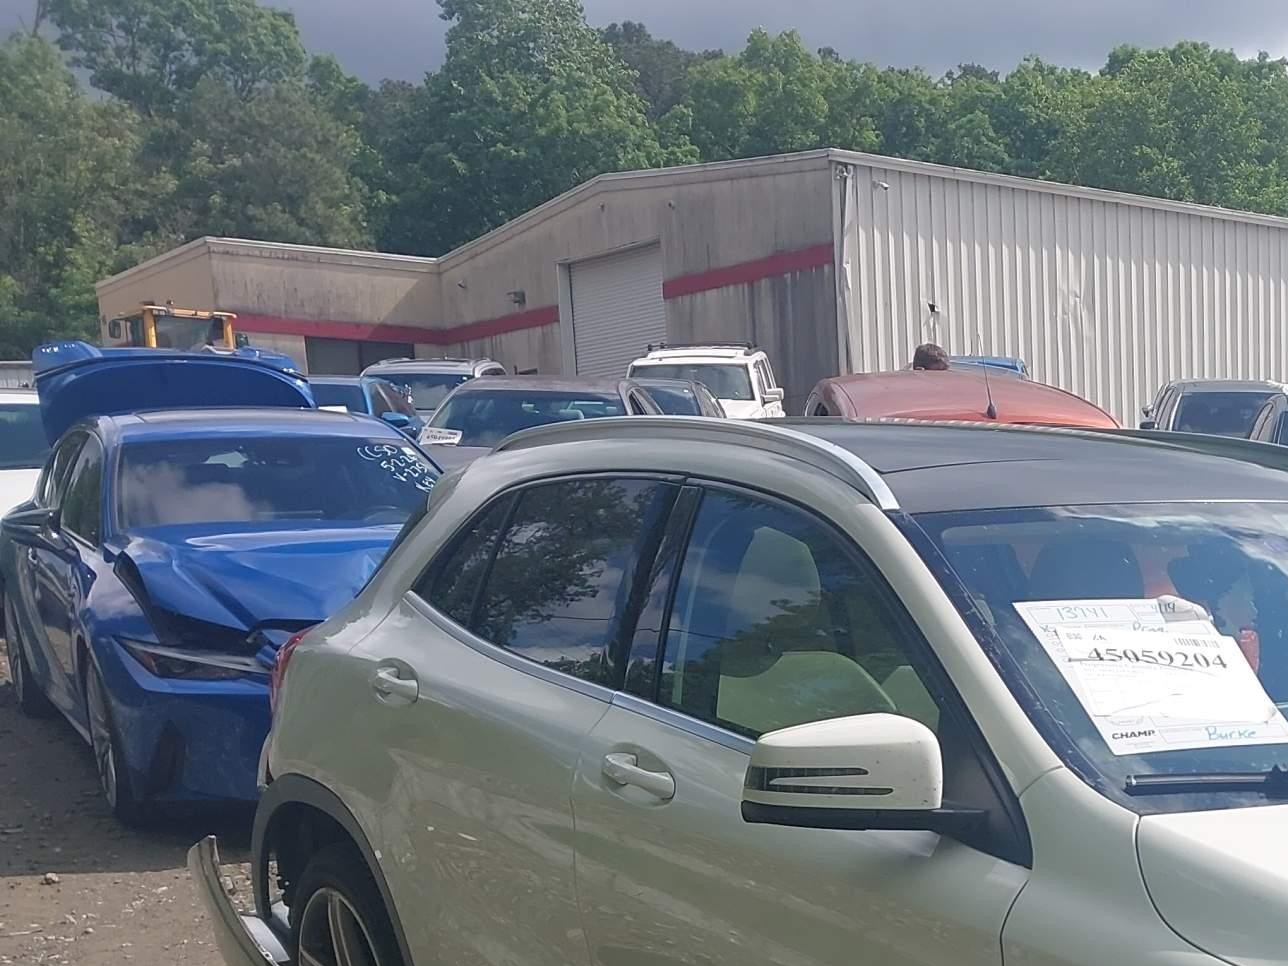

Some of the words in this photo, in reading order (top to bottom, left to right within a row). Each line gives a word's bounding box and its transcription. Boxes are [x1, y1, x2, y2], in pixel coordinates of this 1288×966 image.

[1087, 647, 1228, 669] 45059204
[1111, 729, 1156, 740] CHAMP
[1204, 725, 1258, 741] Burke
